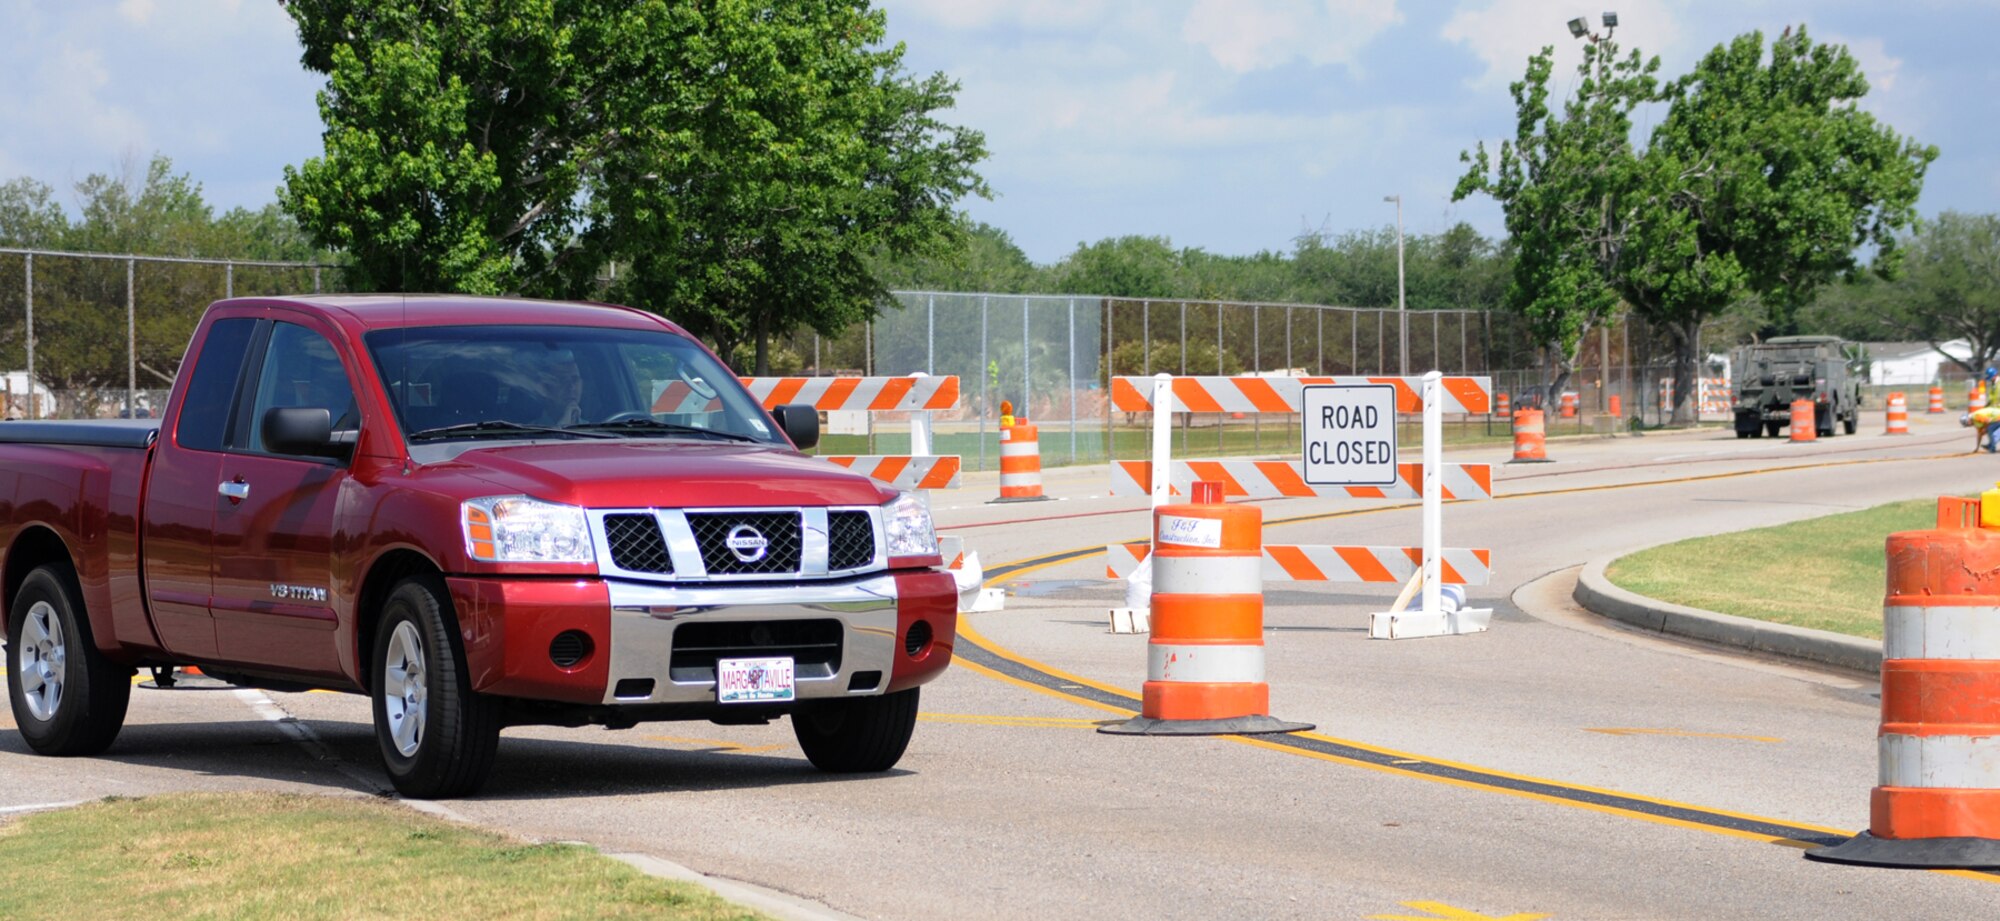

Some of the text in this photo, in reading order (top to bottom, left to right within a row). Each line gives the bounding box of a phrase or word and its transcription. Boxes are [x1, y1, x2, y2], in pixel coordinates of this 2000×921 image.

[1322, 405, 1378, 429] ROAD
[1309, 441, 1391, 464] CLOSED
[270, 583, 327, 601] V8 TITAN
[722, 669, 791, 690] MARGARITAVILLE
